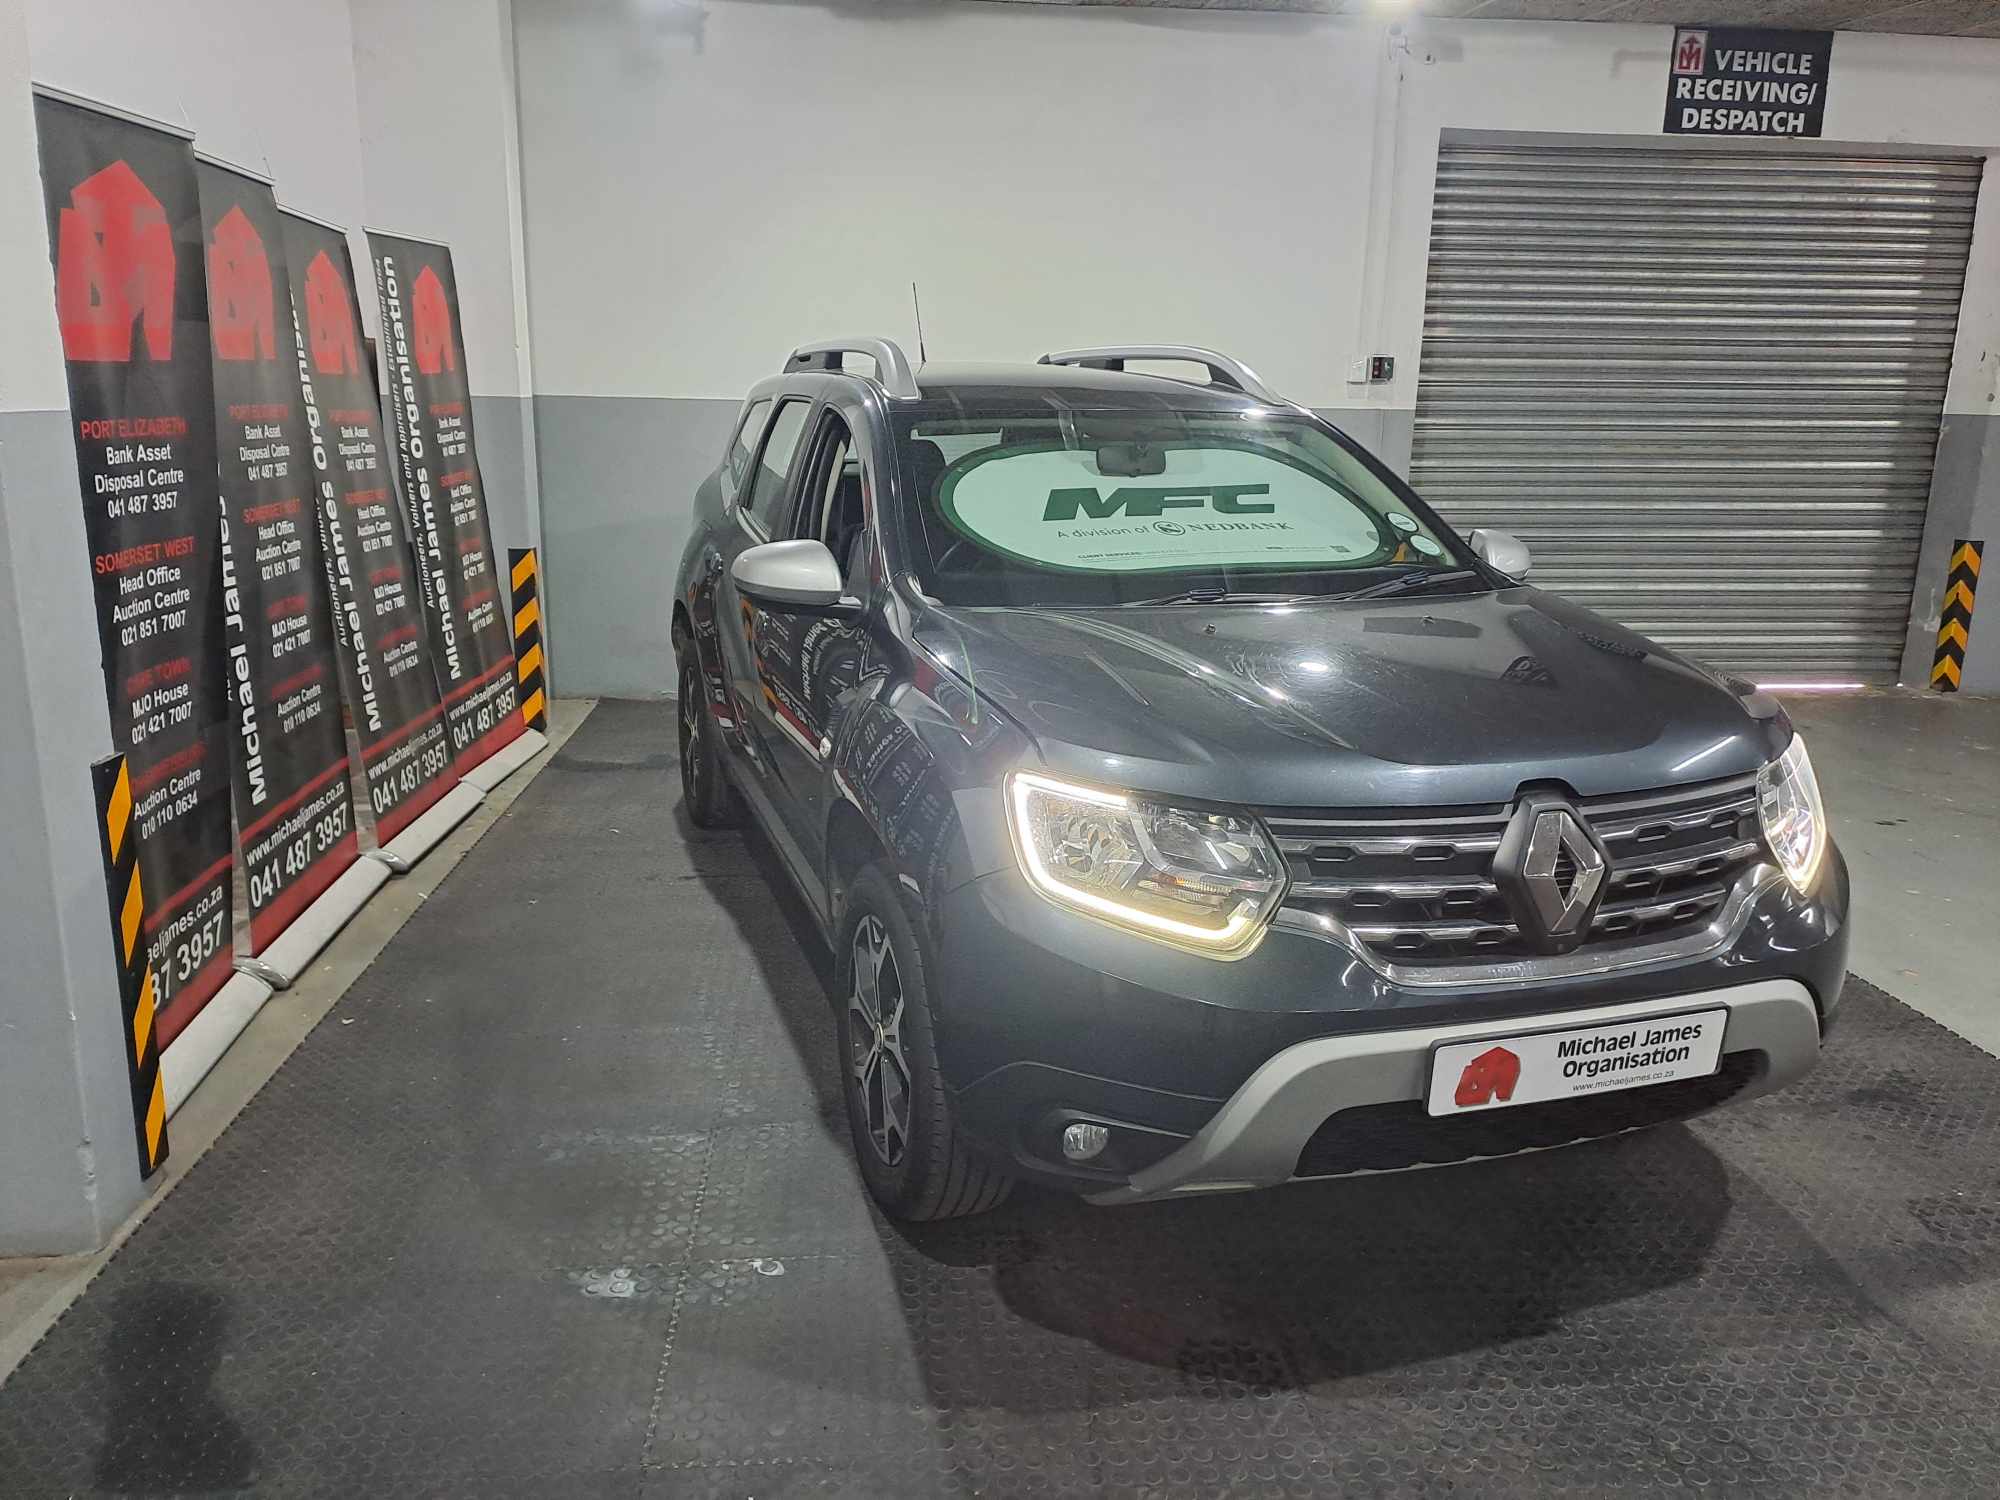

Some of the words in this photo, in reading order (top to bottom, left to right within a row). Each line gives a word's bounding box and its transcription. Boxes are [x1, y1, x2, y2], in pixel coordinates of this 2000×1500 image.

[1715, 50, 1813, 75] VEHICLE
[1676, 78, 1818, 105] RECEIVING/
[1681, 108, 1806, 133] DESPATCH
[383, 256, 424, 460] Organisation
[80, 418, 114, 439] PORT
[391, 383, 409, 451] Appraisers
[106, 446, 133, 465] Bank
[136, 443, 171, 462] Asset
[240, 444, 270, 462] Disposal
[400, 454, 413, 482] and
[95, 470, 144, 494] Disposal
[148, 467, 184, 486] Centre
[107, 498, 125, 519] 041
[128, 495, 148, 515] 487
[152, 491, 178, 511] 3957
[405, 483, 422, 529] Valuers
[417, 466, 442, 561] James
[1043, 483, 1275, 521] MFC
[321, 480, 353, 592] James
[1057, 530, 1070, 539] A
[1071, 526, 1132, 538] division
[1136, 525, 1152, 535] of
[1188, 521, 1295, 533] NEDBANK
[95, 543, 161, 574] SOMERSET
[165, 536, 194, 557] WEST
[255, 545, 281, 562] Auction
[415, 533, 435, 609] Auctioneers,
[120, 575, 143, 596] Head
[146, 565, 181, 588] Office
[113, 598, 151, 623] Auction
[155, 587, 190, 608] Centre
[325, 557, 349, 648] Auctioneers,
[121, 624, 137, 647] 021
[139, 617, 158, 638] 851
[161, 610, 186, 631] 7007
[431, 569, 461, 681] Michael
[343, 601, 382, 733] Michael
[132, 694, 151, 719] MJO
[154, 683, 188, 708] House
[453, 719, 474, 750] 041
[476, 702, 494, 732] 487
[496, 685, 516, 719] 3957
[132, 723, 147, 745] 021
[148, 712, 165, 734] 421
[169, 701, 192, 725] 7007
[230, 644, 267, 806] Michael
[134, 787, 167, 821] Auction
[169, 768, 201, 796] Centre
[373, 776, 398, 814] 041
[400, 760, 420, 793] 487
[422, 740, 448, 778] 3957
[142, 819, 156, 840] 010
[156, 806, 173, 829] 110
[175, 790, 198, 815] 0634
[246, 781, 345, 867] www.michaeljames.co.za
[250, 857, 282, 908] 041
[285, 831, 311, 876] 487
[315, 802, 348, 851] 3957
[177, 909, 224, 981] 3957
[1557, 1031, 1637, 1060] Michael
[1640, 1024, 1702, 1047] James
[1562, 1046, 1689, 1078] Organisation
[1572, 1070, 1674, 1092] www.michaeljames.co.za
